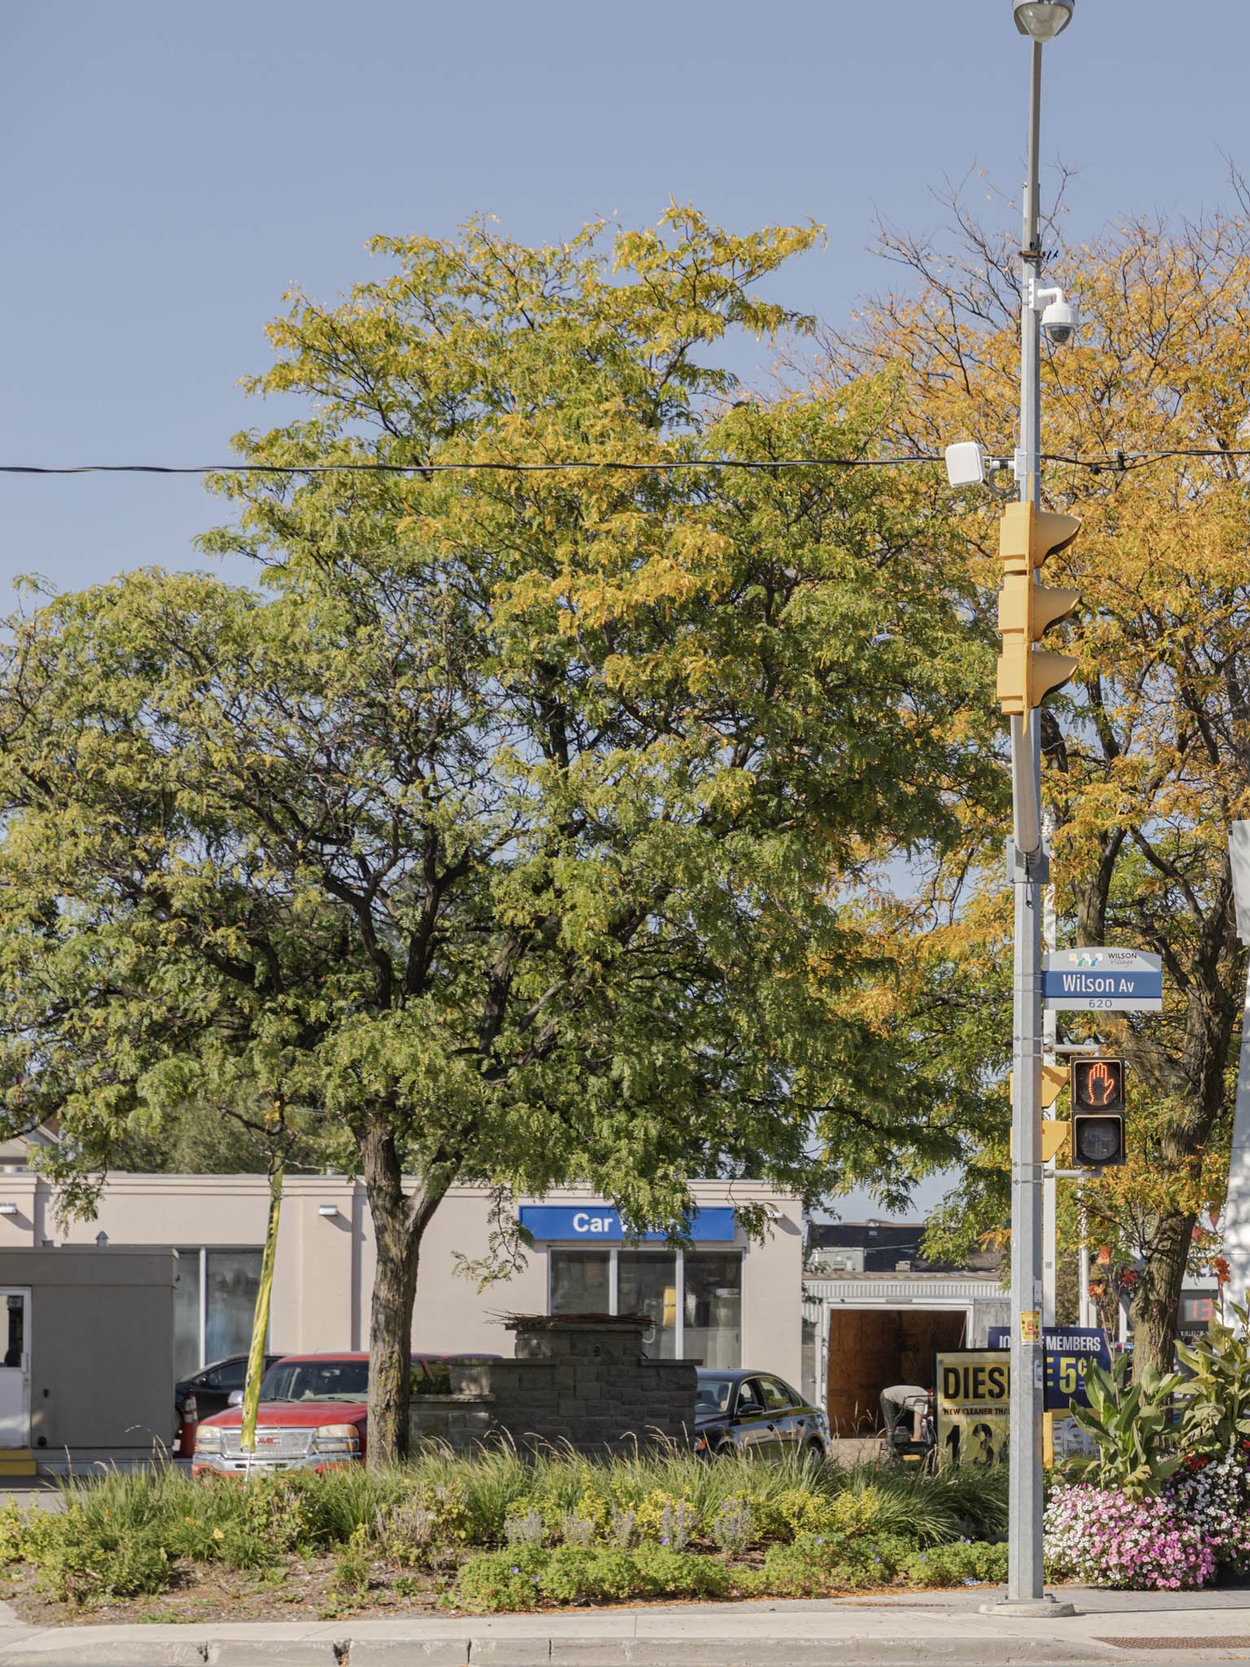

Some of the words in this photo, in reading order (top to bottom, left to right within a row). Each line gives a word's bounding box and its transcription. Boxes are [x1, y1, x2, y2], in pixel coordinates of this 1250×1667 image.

[1063, 974, 1114, 992] Wilson
[1119, 979, 1134, 992] Av
[1088, 999, 1112, 1008] 620
[573, 1213, 613, 1232] Car
[1046, 1336, 1101, 1351] MEMBERS
[944, 1367, 1010, 1399] DIES
